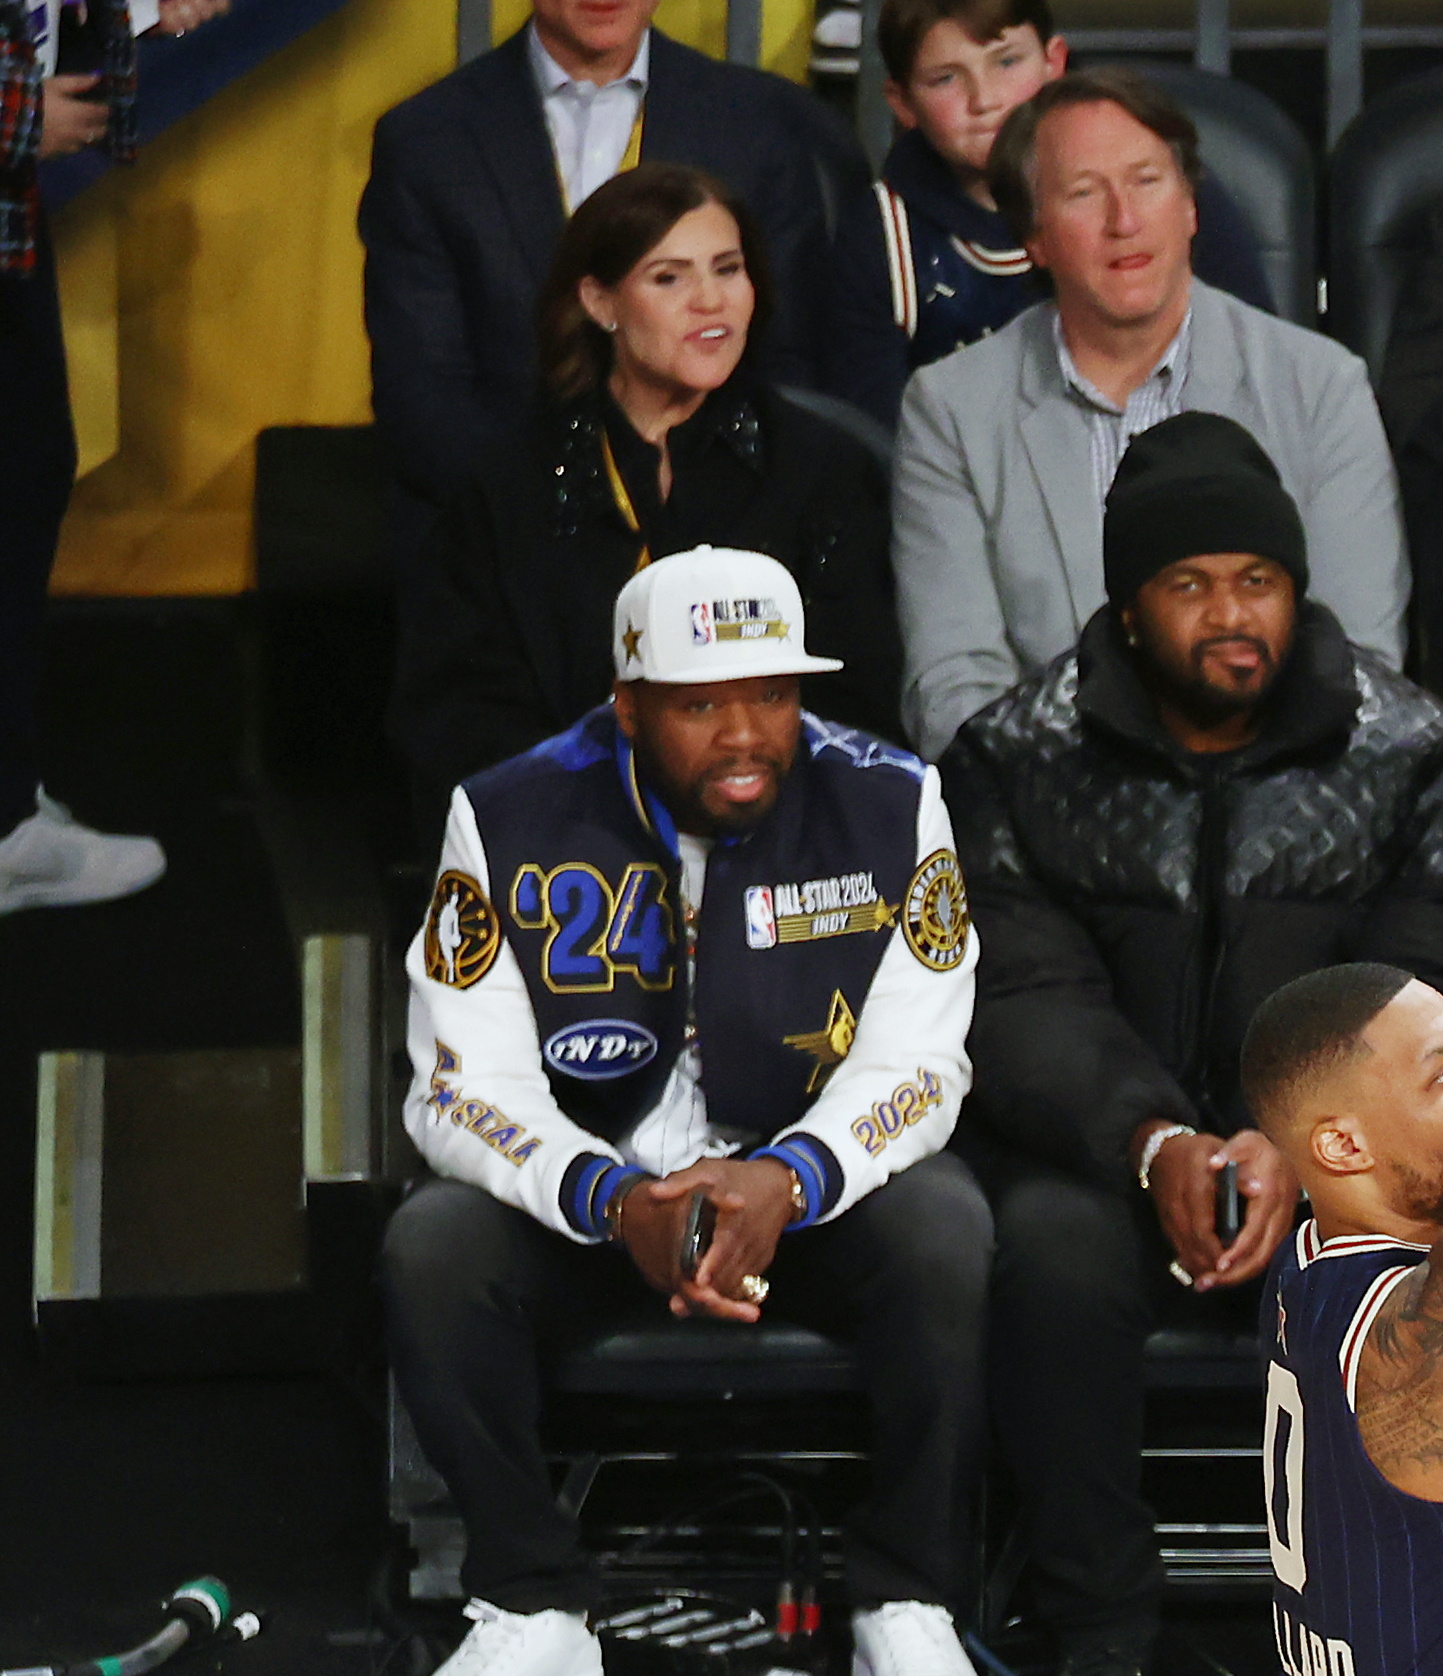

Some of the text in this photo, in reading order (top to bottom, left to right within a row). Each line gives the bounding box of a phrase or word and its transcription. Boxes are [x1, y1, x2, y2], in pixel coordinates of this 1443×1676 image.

[841, 870, 878, 907] 2024
[811, 911, 848, 935] INDY
[553, 1034, 648, 1064] INDY
[851, 1067, 943, 1158] 2024
[1264, 1359, 1306, 1595] 0
